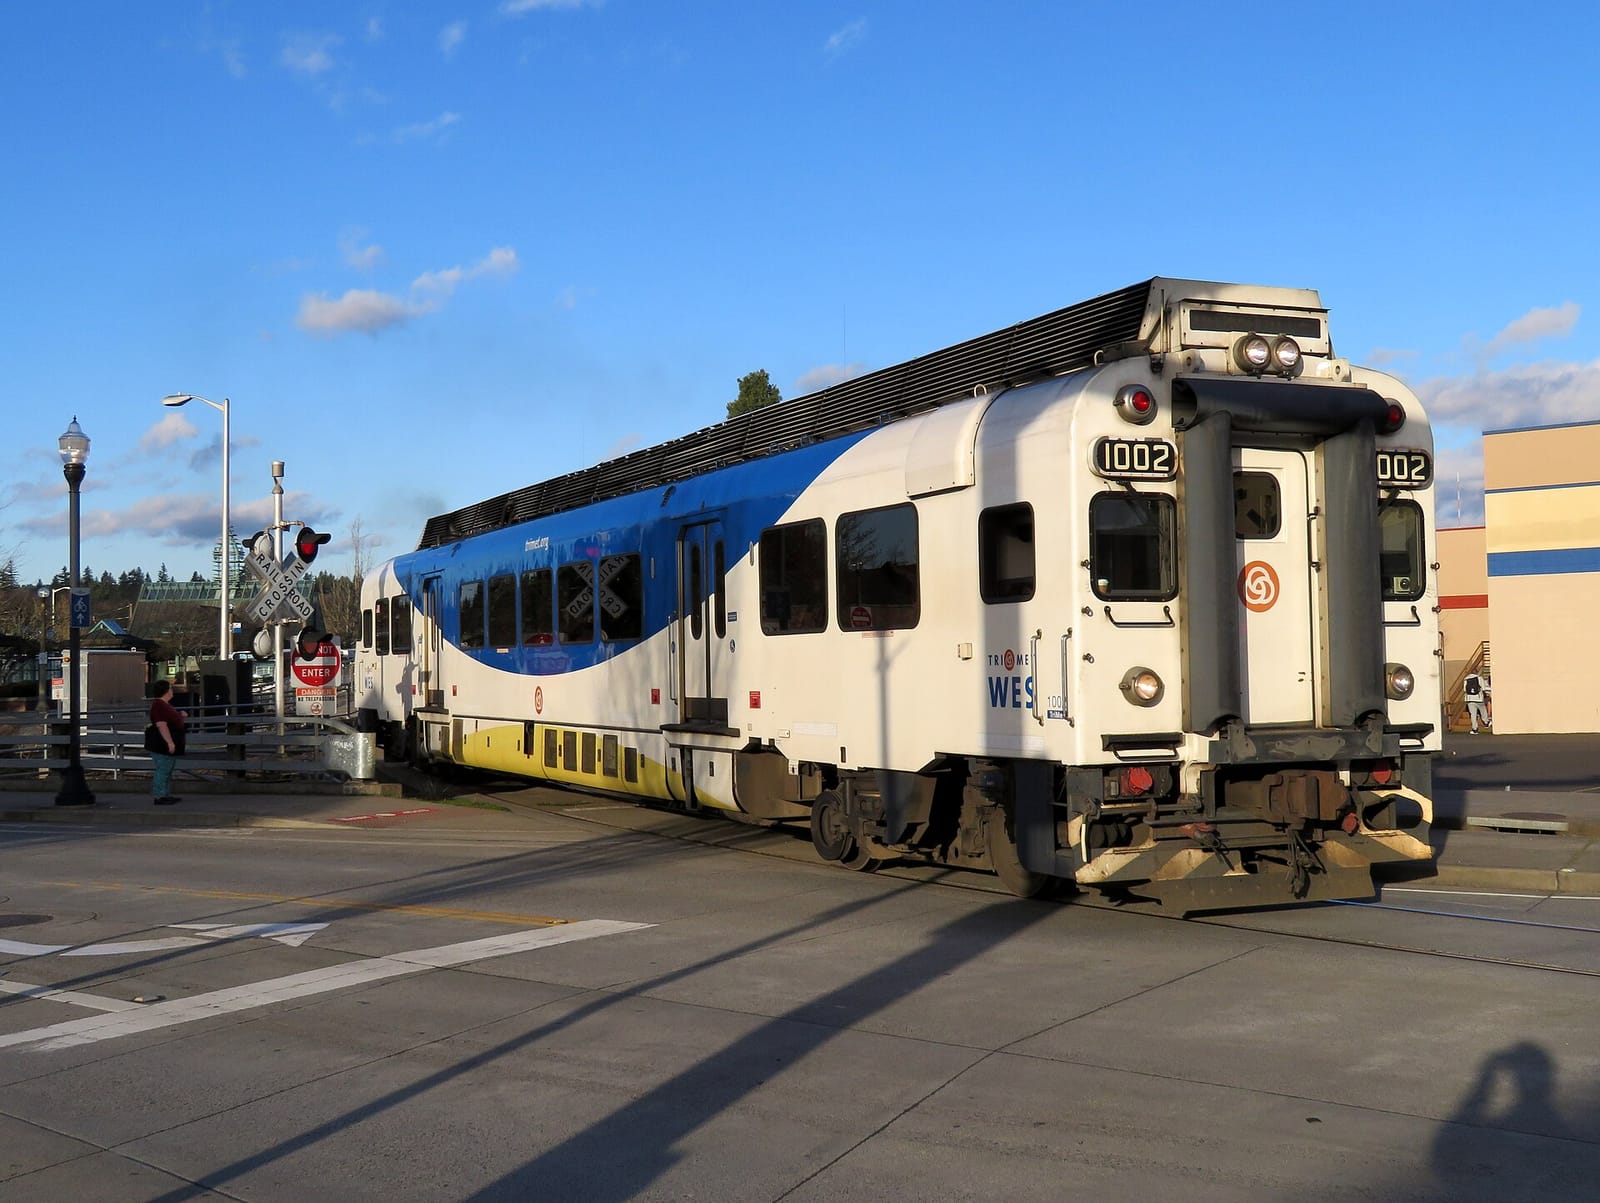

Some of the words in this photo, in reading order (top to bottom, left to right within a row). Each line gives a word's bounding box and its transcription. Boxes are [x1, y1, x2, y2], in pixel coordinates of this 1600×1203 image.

[1105, 443, 1169, 471] 1002
[1376, 454, 1425, 480] 002
[256, 553, 280, 583] RAIL
[284, 588, 311, 617] ROAD
[259, 562, 304, 616] CROSSIN
[302, 669, 330, 677] ENTER
[988, 654, 1004, 666] TRI
[1016, 654, 1029, 666] ME
[988, 676, 1034, 708] WES
[1047, 695, 1062, 708] 100
